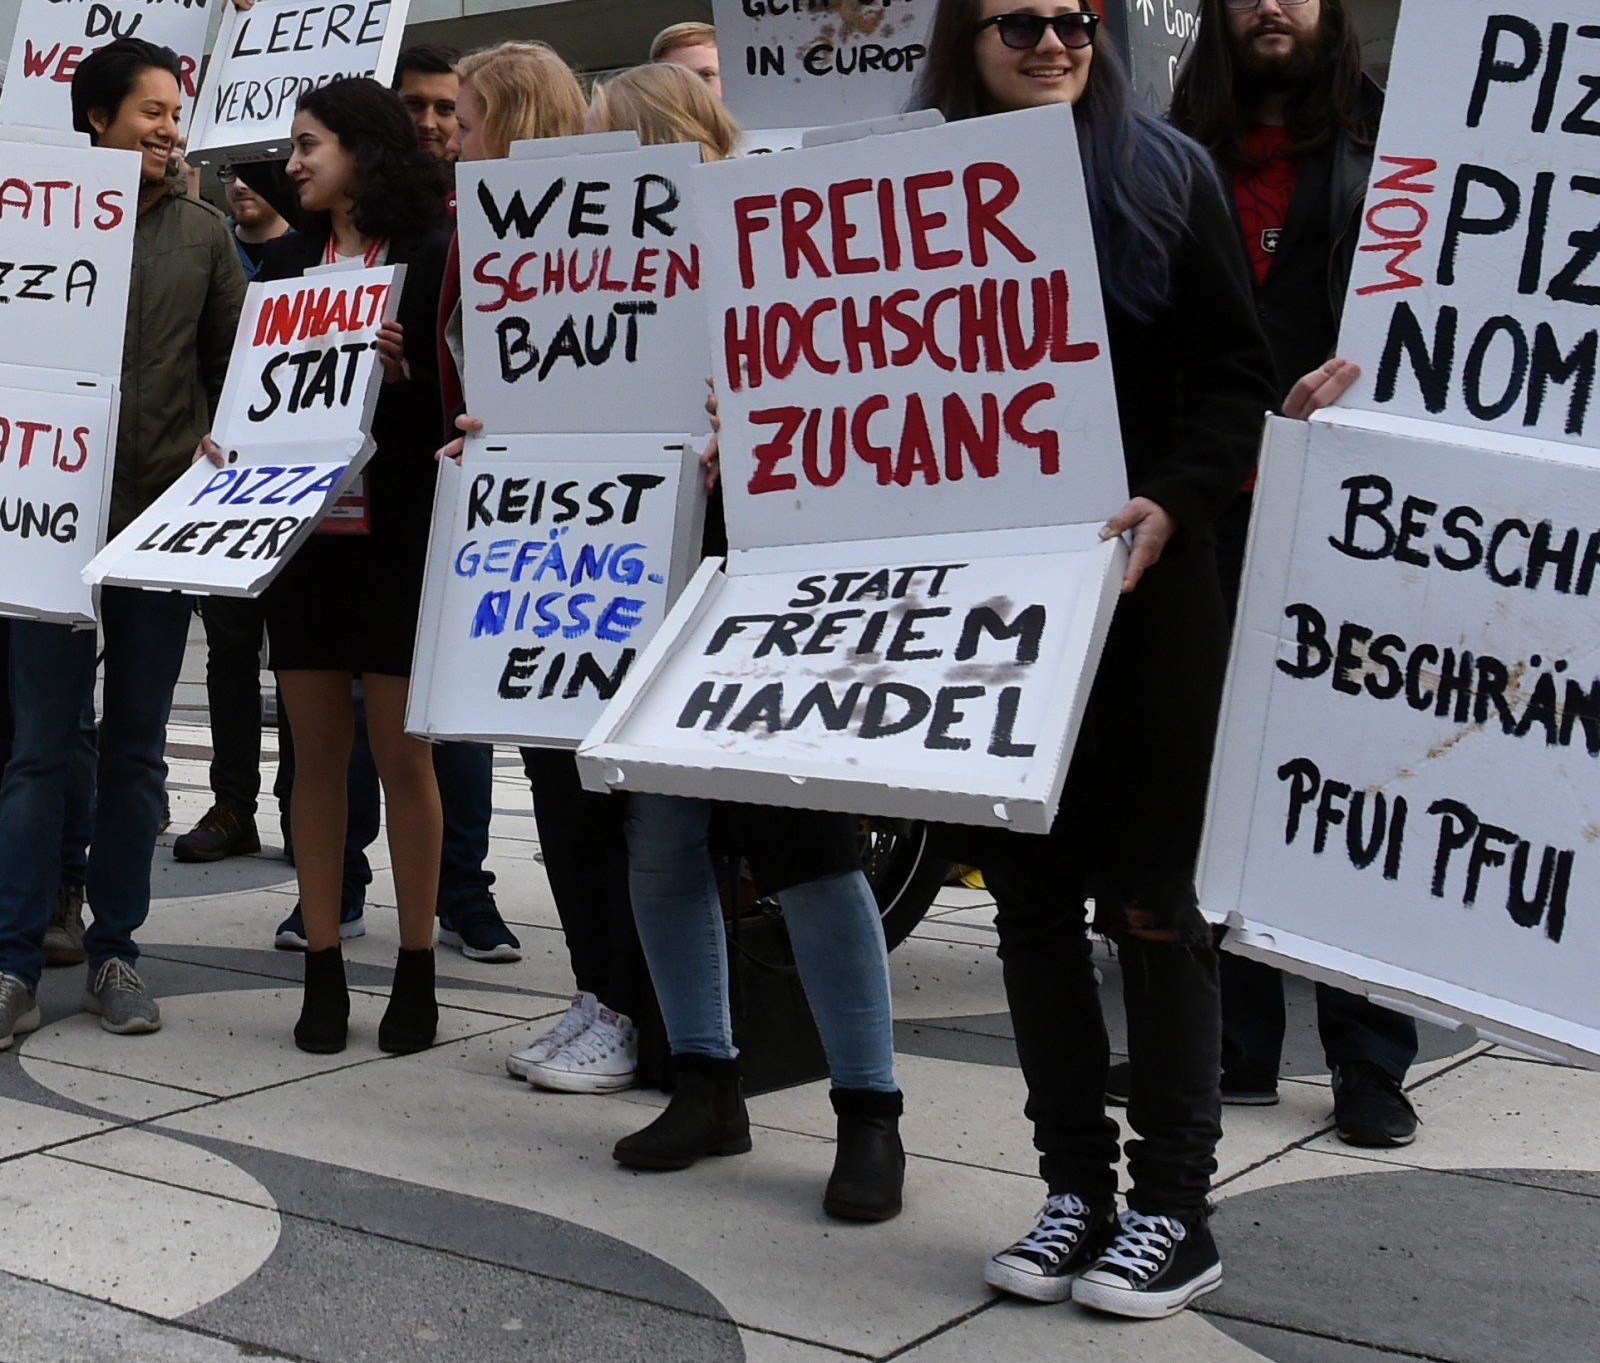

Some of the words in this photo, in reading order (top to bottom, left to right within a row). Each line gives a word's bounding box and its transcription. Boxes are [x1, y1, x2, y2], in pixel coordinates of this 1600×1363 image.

[84, 2, 143, 39] DU
[231, 0, 392, 60] LEERE
[746, 45, 785, 75] IN
[477, 173, 682, 240] WER
[733, 161, 1037, 289] FREIER
[1356, 155, 1438, 295] NOM
[471, 242, 700, 313] SCHULEN
[496, 300, 657, 384] BAUT
[724, 270, 1101, 392] HOCHSCHUL
[1373, 301, 1599, 436] NOM
[747, 381, 1061, 495] ZUGANG
[188, 466, 349, 506] PIZZA
[466, 473, 666, 532] REISST
[469, 589, 646, 643] NISSE
[788, 563, 969, 608] STATT
[702, 604, 1048, 666] FREIEM
[498, 646, 637, 701] EIN
[675, 680, 1038, 757] HANDEL
[1277, 757, 1408, 880] PFUI
[1427, 798, 1575, 943] PFUI
